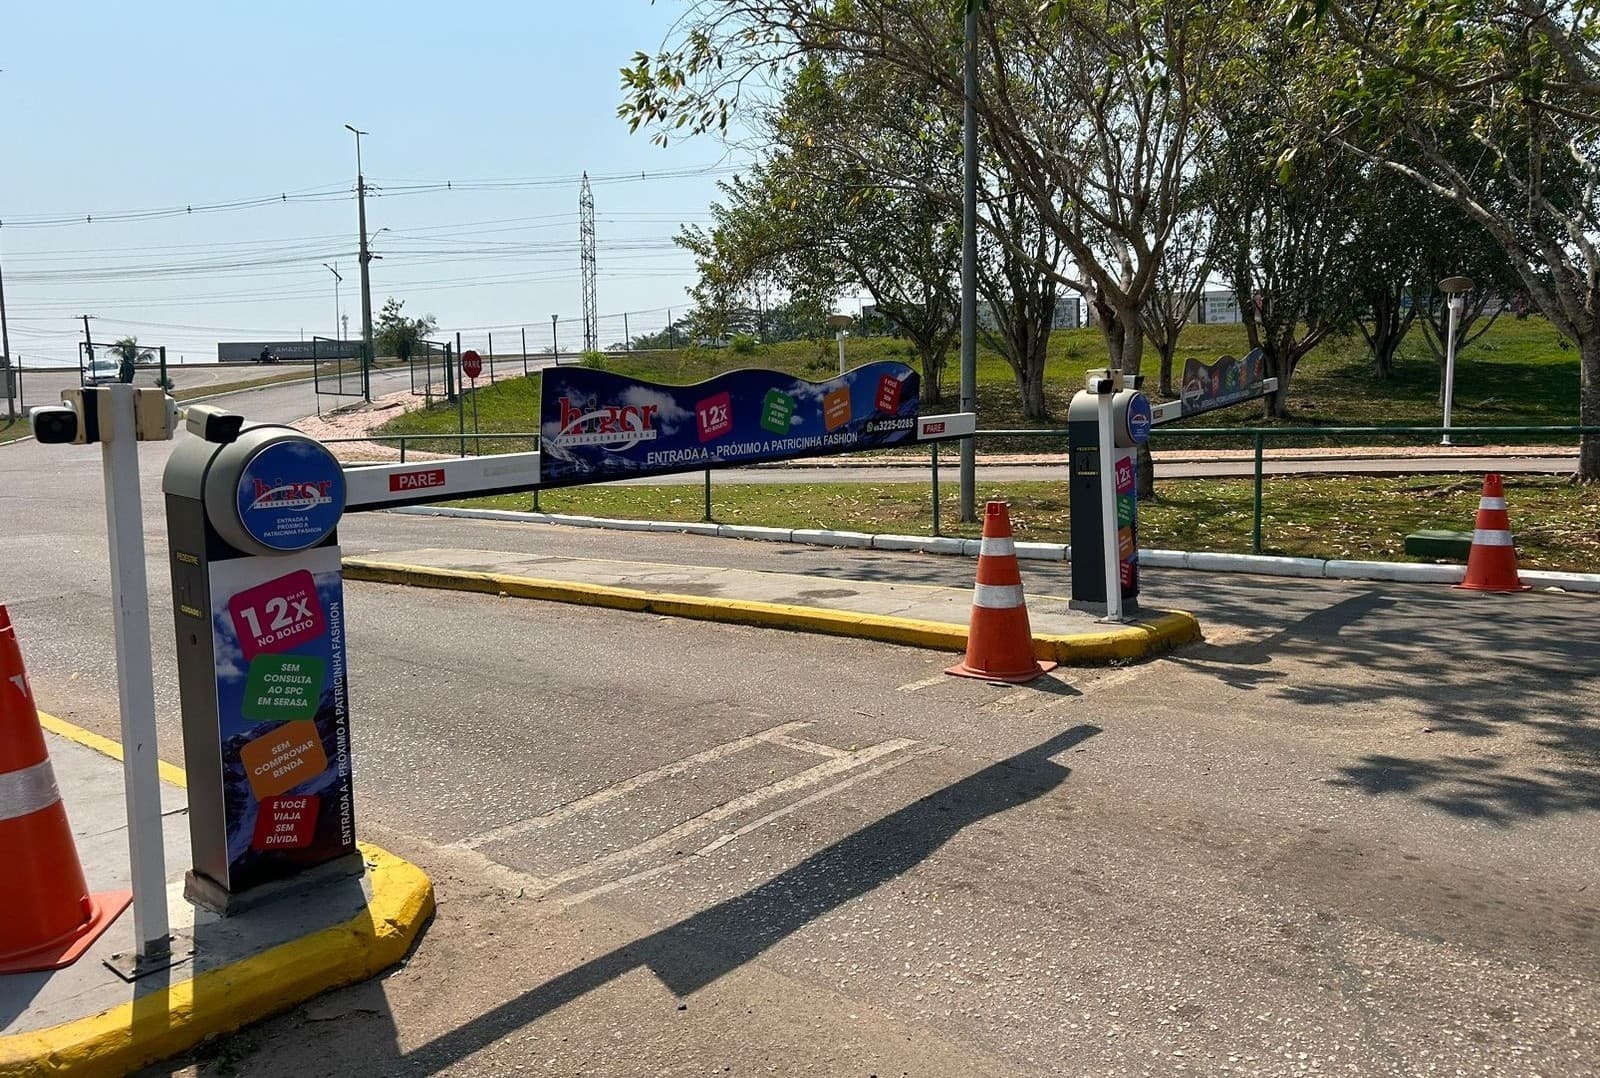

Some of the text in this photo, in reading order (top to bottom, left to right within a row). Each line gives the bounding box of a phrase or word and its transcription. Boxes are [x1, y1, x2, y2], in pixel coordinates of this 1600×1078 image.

[647, 448, 700, 465] ENTRADA
[701, 447, 709, 459] A
[716, 441, 761, 457] PRÓXIMO
[762, 439, 770, 451] A
[771, 435, 822, 451] PATRICINHA
[823, 432, 859, 445] FASHION
[399, 472, 437, 488] PARE
[329, 601, 341, 650] FASHION
[257, 619, 314, 647] NO BOLETO
[281, 663, 300, 672] SEM
[263, 674, 312, 684] CONSULTA
[332, 652, 345, 715] PATRICINHA
[267, 686, 304, 695] AO SPC
[257, 697, 308, 707] EM SERASA
[336, 716, 345, 726] A
[271, 741, 291, 755] SEM
[336, 727, 348, 778] PRÓXIMO
[254, 740, 315, 776] COMPROVAR
[272, 758, 305, 779] RENDA
[340, 784, 349, 795] A
[273, 798, 307, 809] E VOCÊ
[273, 812, 301, 821] VIAJA
[340, 798, 352, 846] ENTRADA
[275, 823, 294, 832] SEM
[265, 834, 298, 844] DÍVIDA
